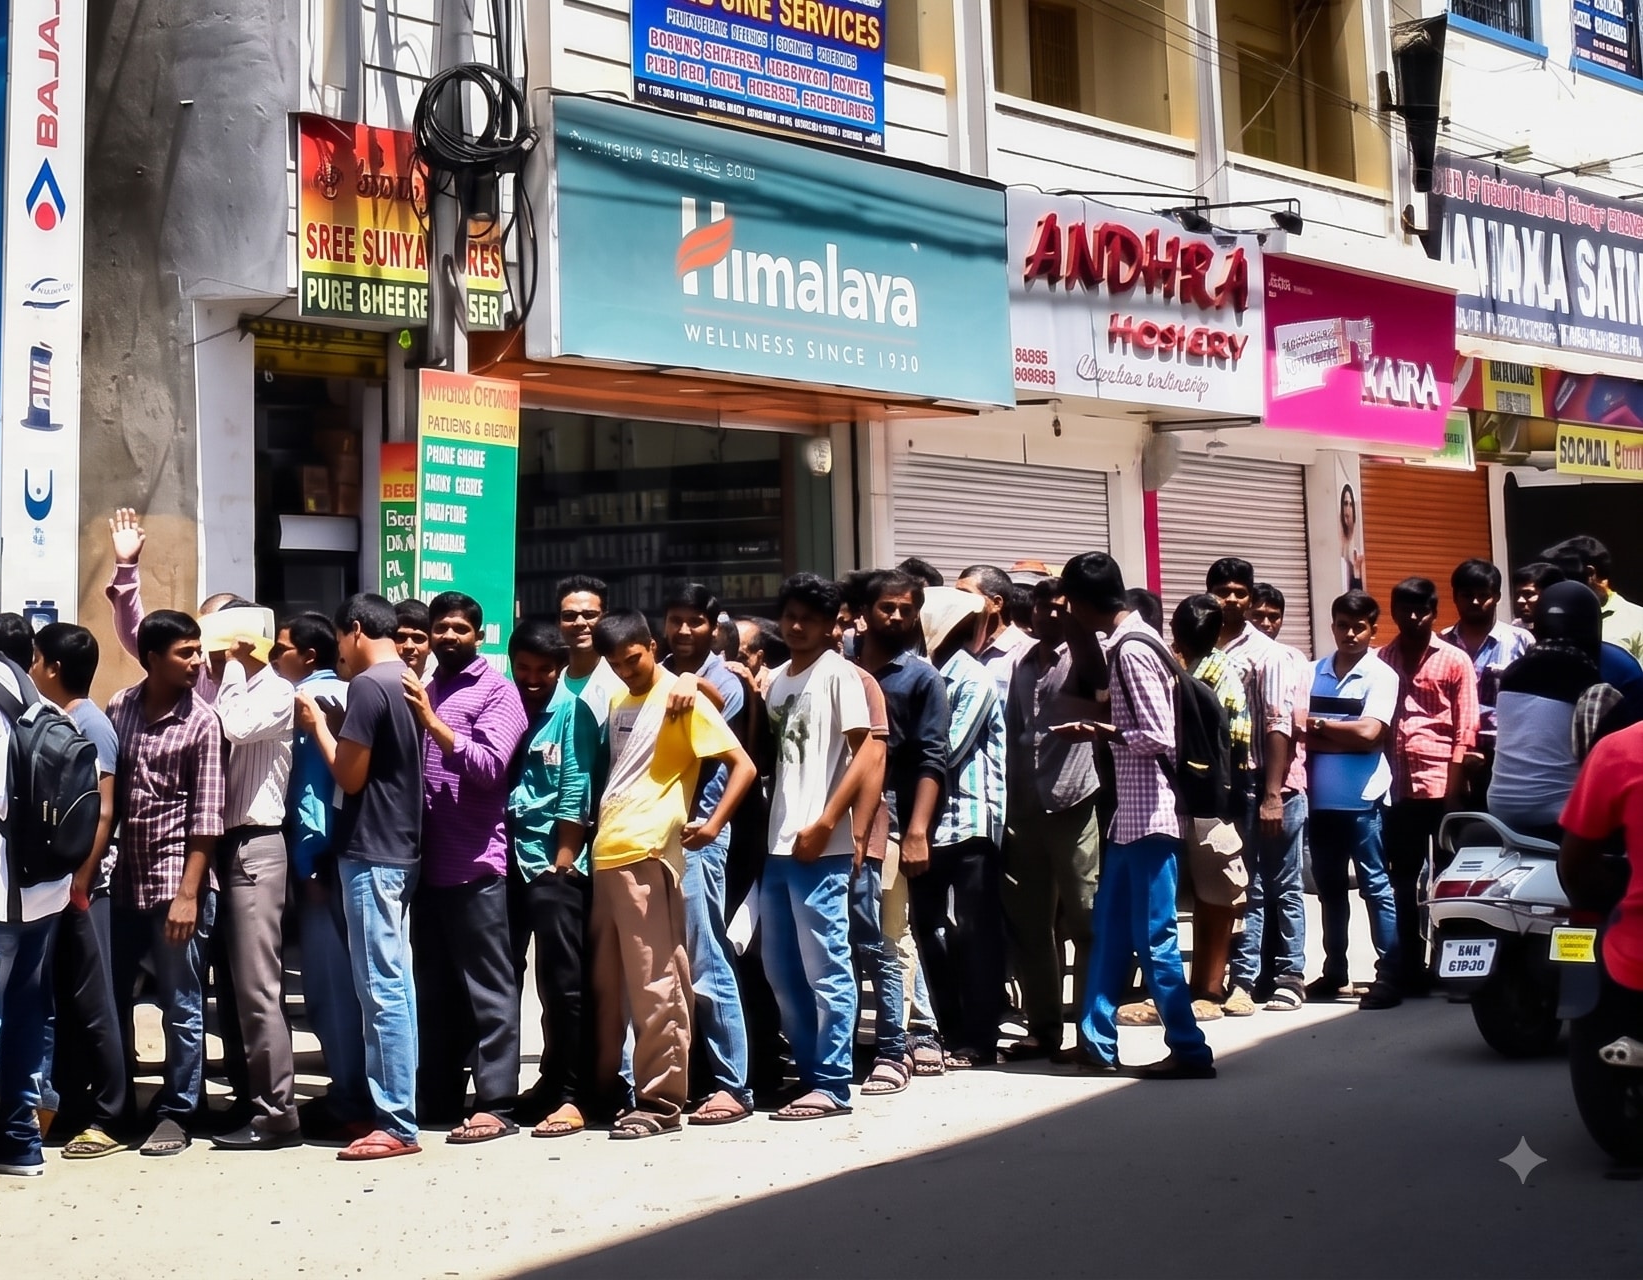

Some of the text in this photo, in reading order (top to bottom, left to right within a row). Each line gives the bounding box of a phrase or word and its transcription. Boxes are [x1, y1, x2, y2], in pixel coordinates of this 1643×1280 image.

[779, 0, 880, 49] SERVICES
[306, 222, 356, 264] SREE
[363, 229, 428, 271] SUNYA
[676, 196, 919, 328] Himalaya
[1023, 212, 1249, 313] ANDHRA
[307, 278, 354, 312] PURE
[468, 294, 499, 326] SER
[684, 323, 919, 374] WELLNESS SINCE 1930
[1108, 313, 1249, 361] HOSIERY
